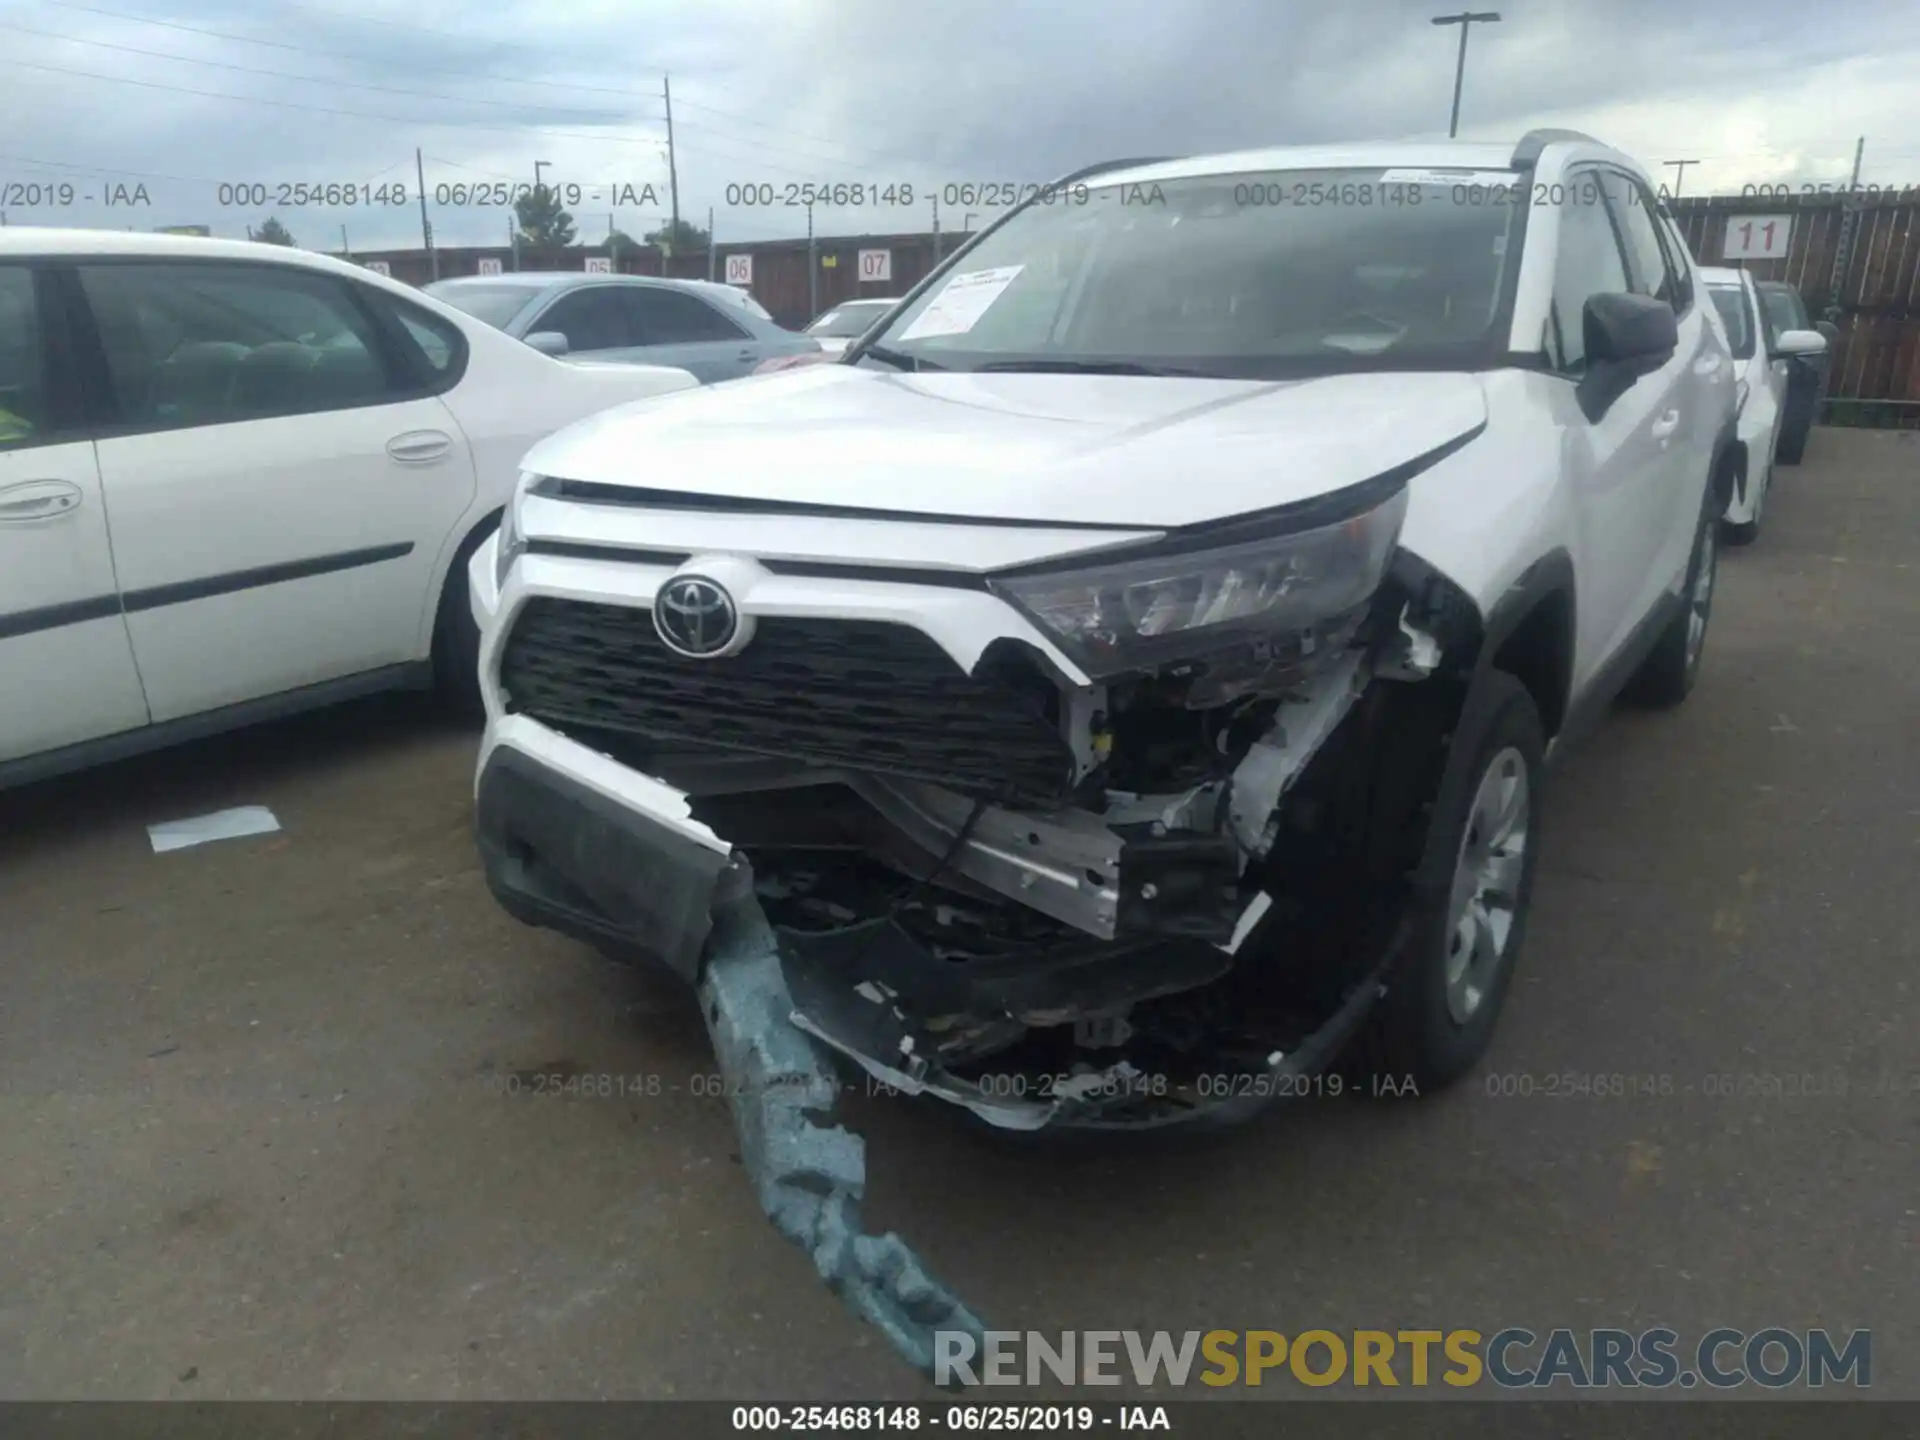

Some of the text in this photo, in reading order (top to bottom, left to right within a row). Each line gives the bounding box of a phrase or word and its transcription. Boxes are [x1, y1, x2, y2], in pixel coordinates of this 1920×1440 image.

[1738, 220, 1776, 252] 11
[729, 259, 748, 280] 06
[863, 254, 886, 275] 07
